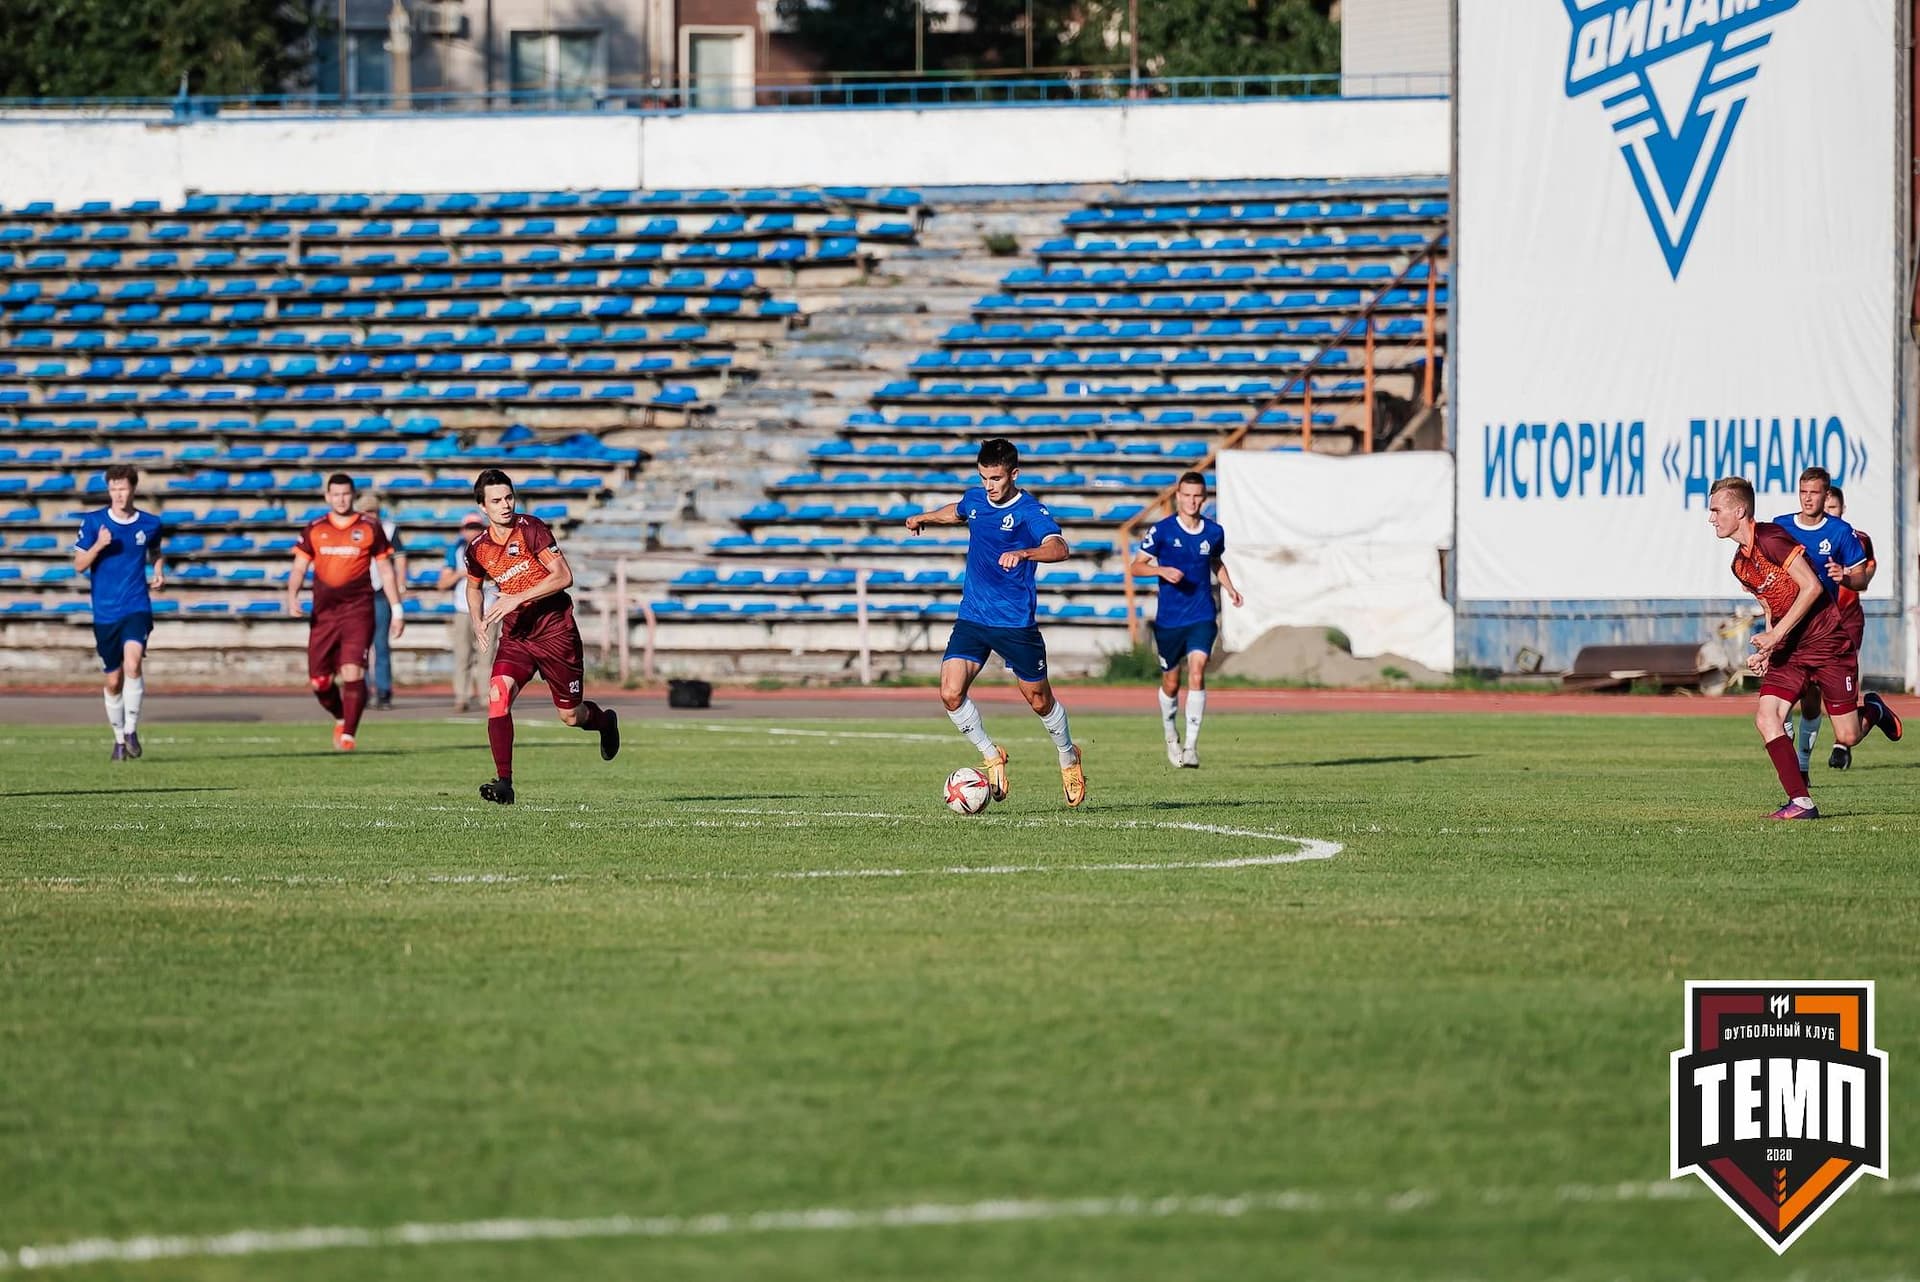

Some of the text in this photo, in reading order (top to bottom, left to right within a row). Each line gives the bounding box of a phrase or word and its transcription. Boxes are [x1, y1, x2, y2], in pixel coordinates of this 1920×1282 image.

[1484, 420, 1646, 499] ИСТОРИЯ
[569, 680, 580, 694] 23
[1845, 675, 1852, 692] 6
